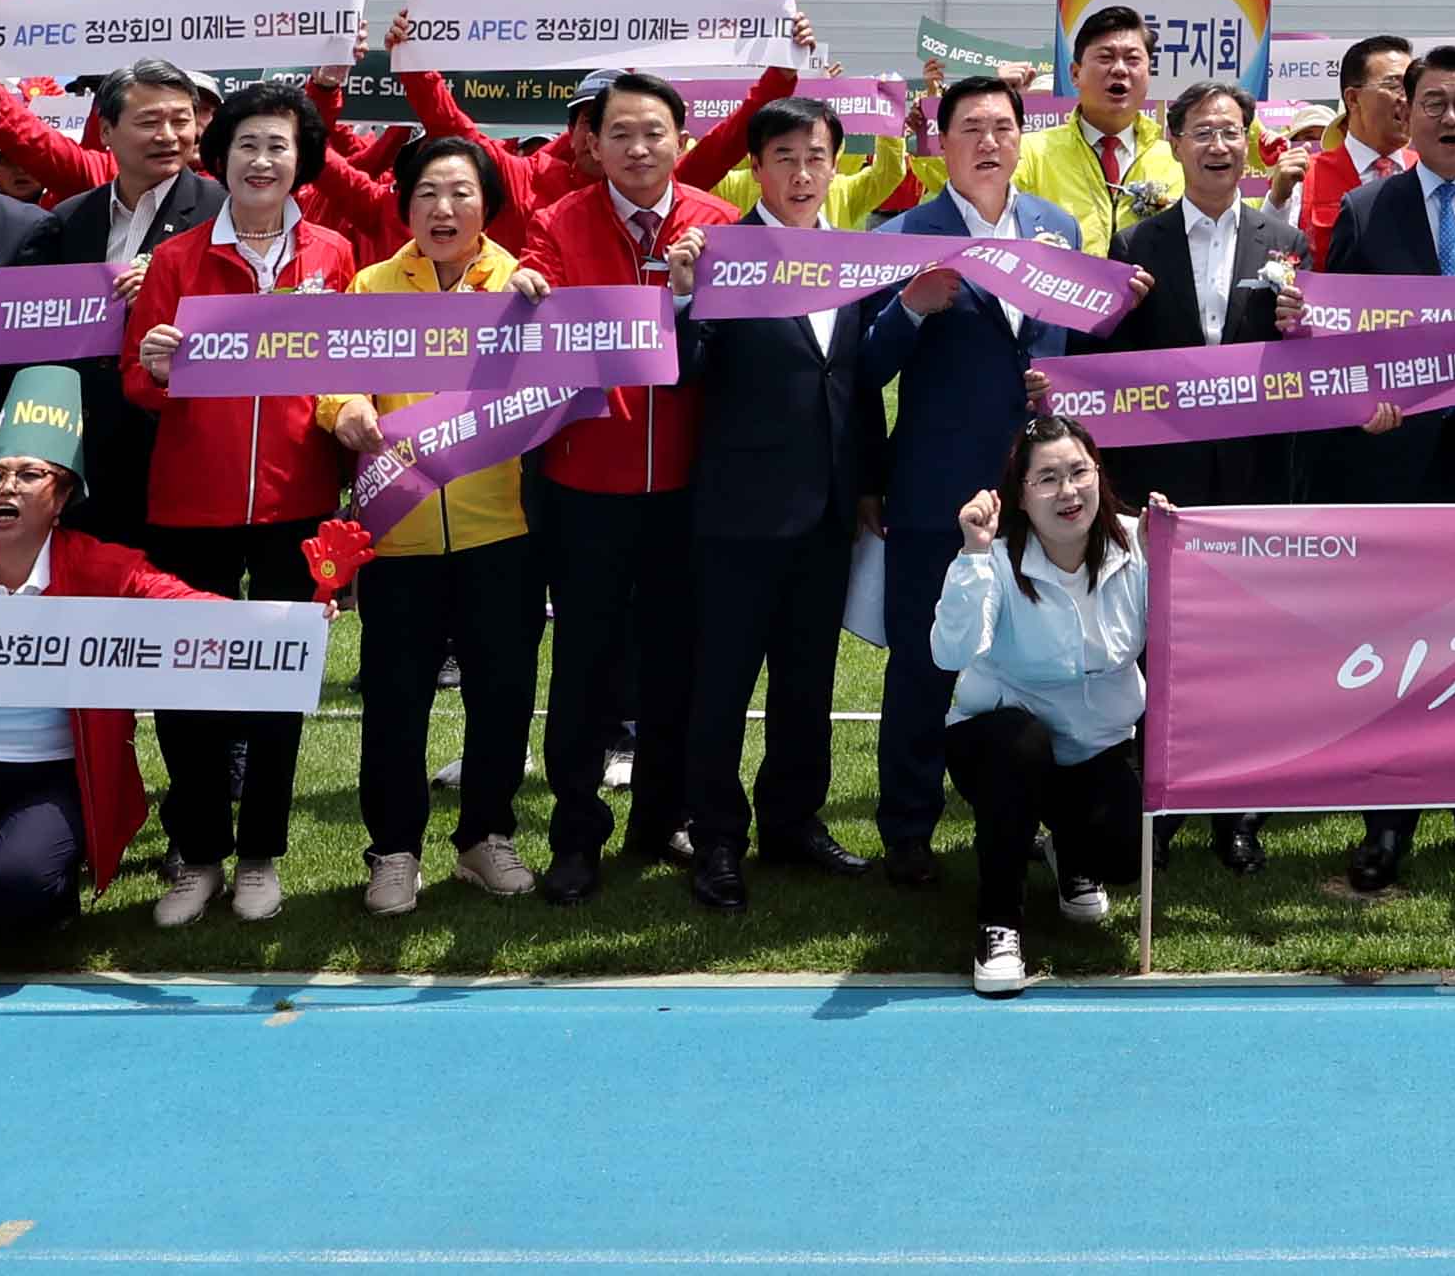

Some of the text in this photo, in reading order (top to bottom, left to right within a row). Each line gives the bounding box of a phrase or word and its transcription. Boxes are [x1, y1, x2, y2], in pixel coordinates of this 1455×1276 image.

[13, 24, 77, 45] APEC
[85, 18, 172, 44] 정상회의
[181, 15, 244, 40] 이제는
[407, 18, 689, 42] 2025 APEC 정상회의 이제는
[922, 35, 983, 65] 2025 APEC
[1279, 62, 1319, 77] APEC
[713, 262, 766, 287] 2025
[772, 262, 833, 287] APEC
[1021, 264, 1114, 316] 기원합니다.
[1, 297, 106, 328] 기원합니다.
[1301, 304, 1351, 331] 2025
[188, 320, 663, 360] 2025 APEC 정상회의 인천 유치를 기원합니다.
[1051, 392, 1106, 417] 2025
[1112, 386, 1170, 414] APEC
[1176, 380, 1257, 409] 정상회의
[1263, 372, 1303, 400] 인천
[1310, 366, 1369, 396] 유치를
[12, 398, 74, 430] Now,
[418, 411, 477, 456] 유치를
[1184, 538, 1200, 551] all
[1203, 540, 1237, 554] ways
[80, 636, 162, 669] 이제는
[173, 639, 308, 672] 인천입니다
